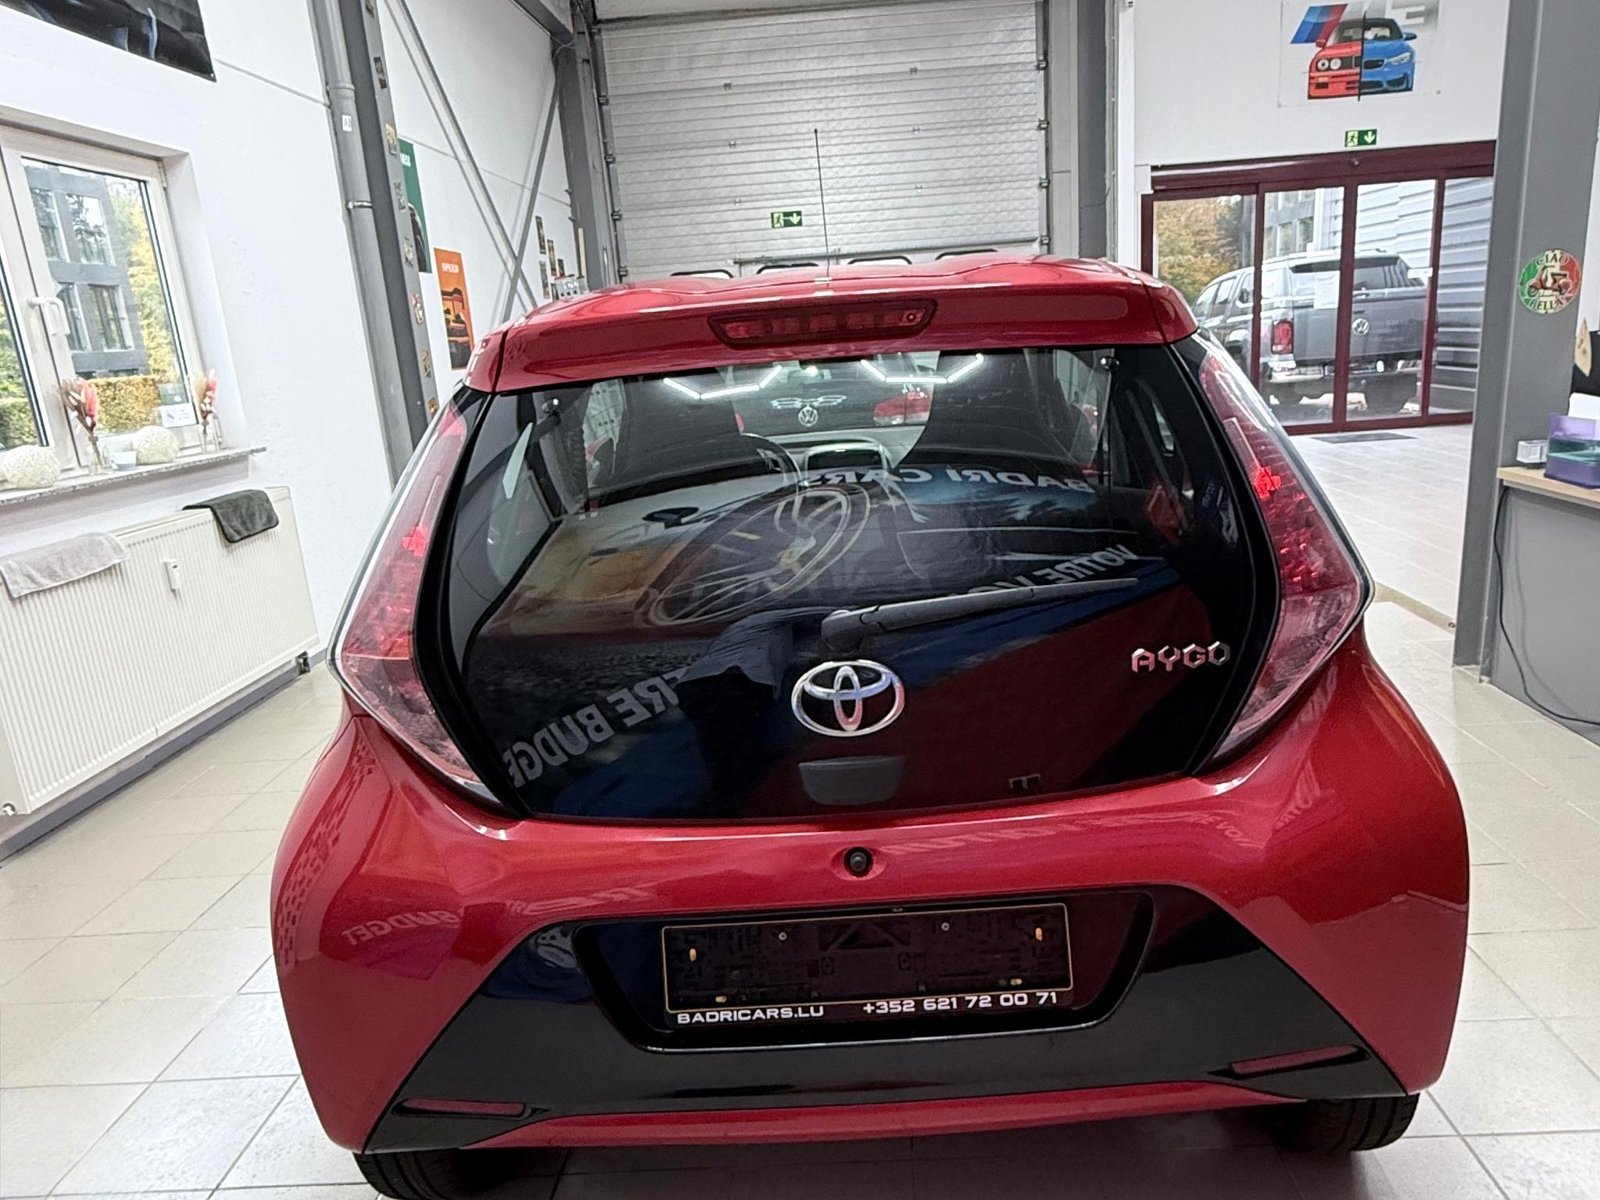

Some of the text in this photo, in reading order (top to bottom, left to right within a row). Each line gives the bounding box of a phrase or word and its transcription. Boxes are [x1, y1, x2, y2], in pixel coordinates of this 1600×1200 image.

[1535, 253, 1569, 267] CIAO
[1529, 298, 1564, 311] BELLA
[1131, 641, 1231, 673] AYGO
[677, 991, 1057, 1024] BADRICARS.LU +352 621 72 00 71
